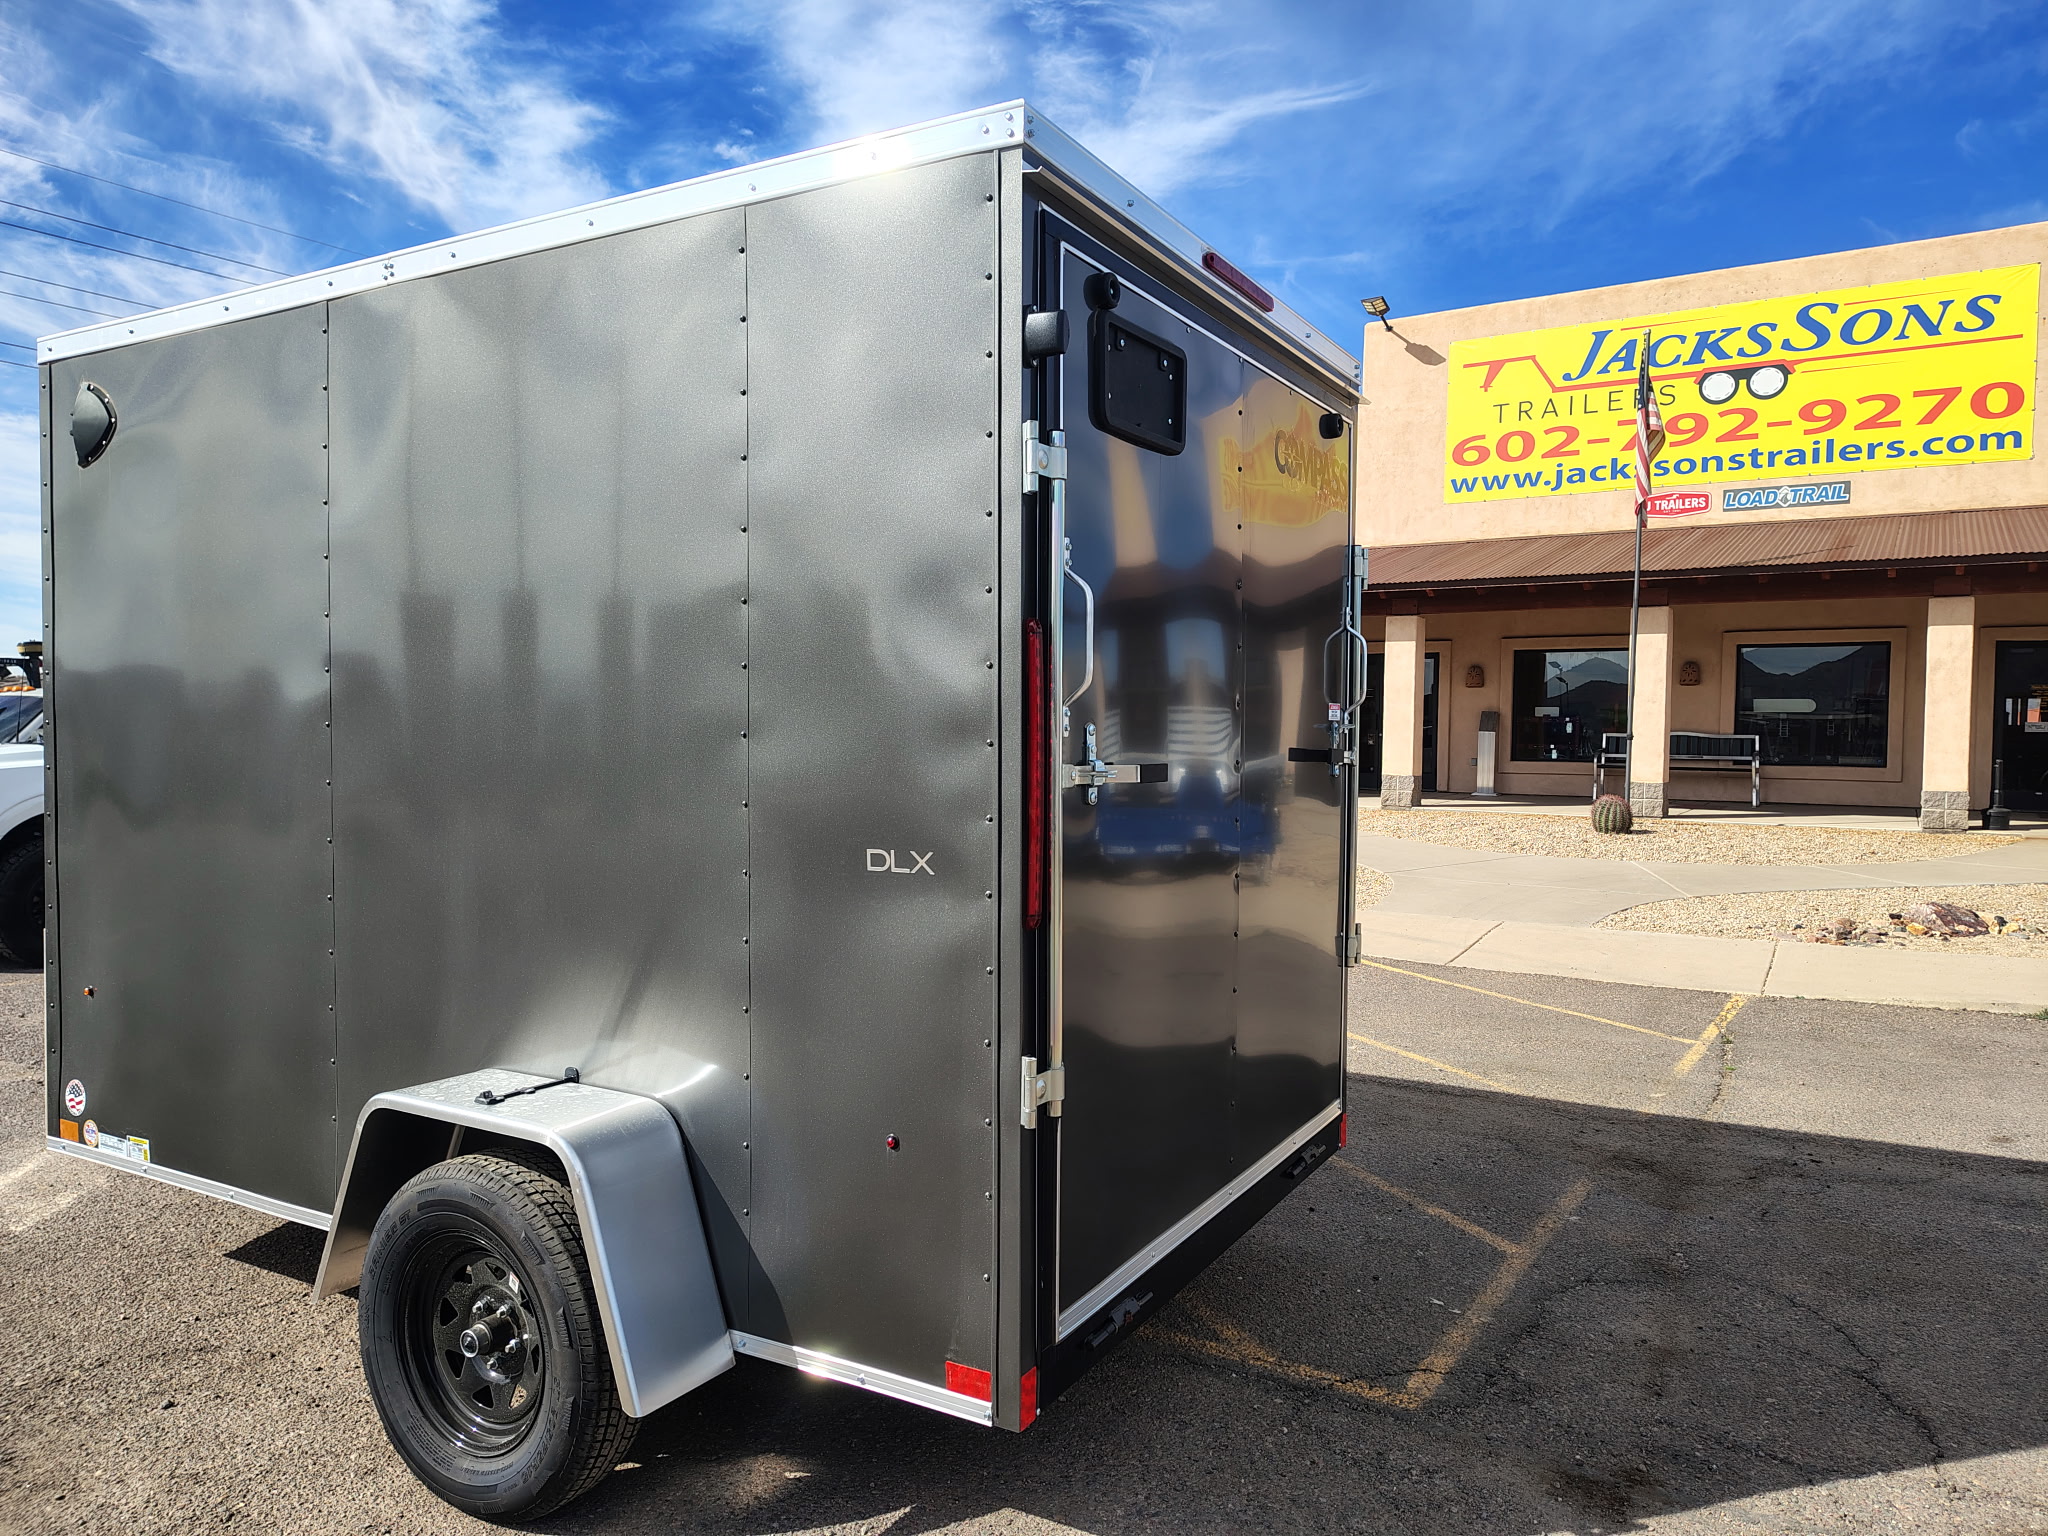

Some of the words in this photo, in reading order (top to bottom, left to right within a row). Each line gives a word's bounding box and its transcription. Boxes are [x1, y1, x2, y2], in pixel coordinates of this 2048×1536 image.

[1452, 381, 2025, 467] 602-792-9270
[1450, 431, 2022, 493] www.jacksonstrailers.com
[1654, 497, 1707, 511] TRAILERS
[1724, 490, 1779, 509] LOAD
[1789, 484, 1849, 504] TRAIL
[866, 848, 936, 876] DLX
